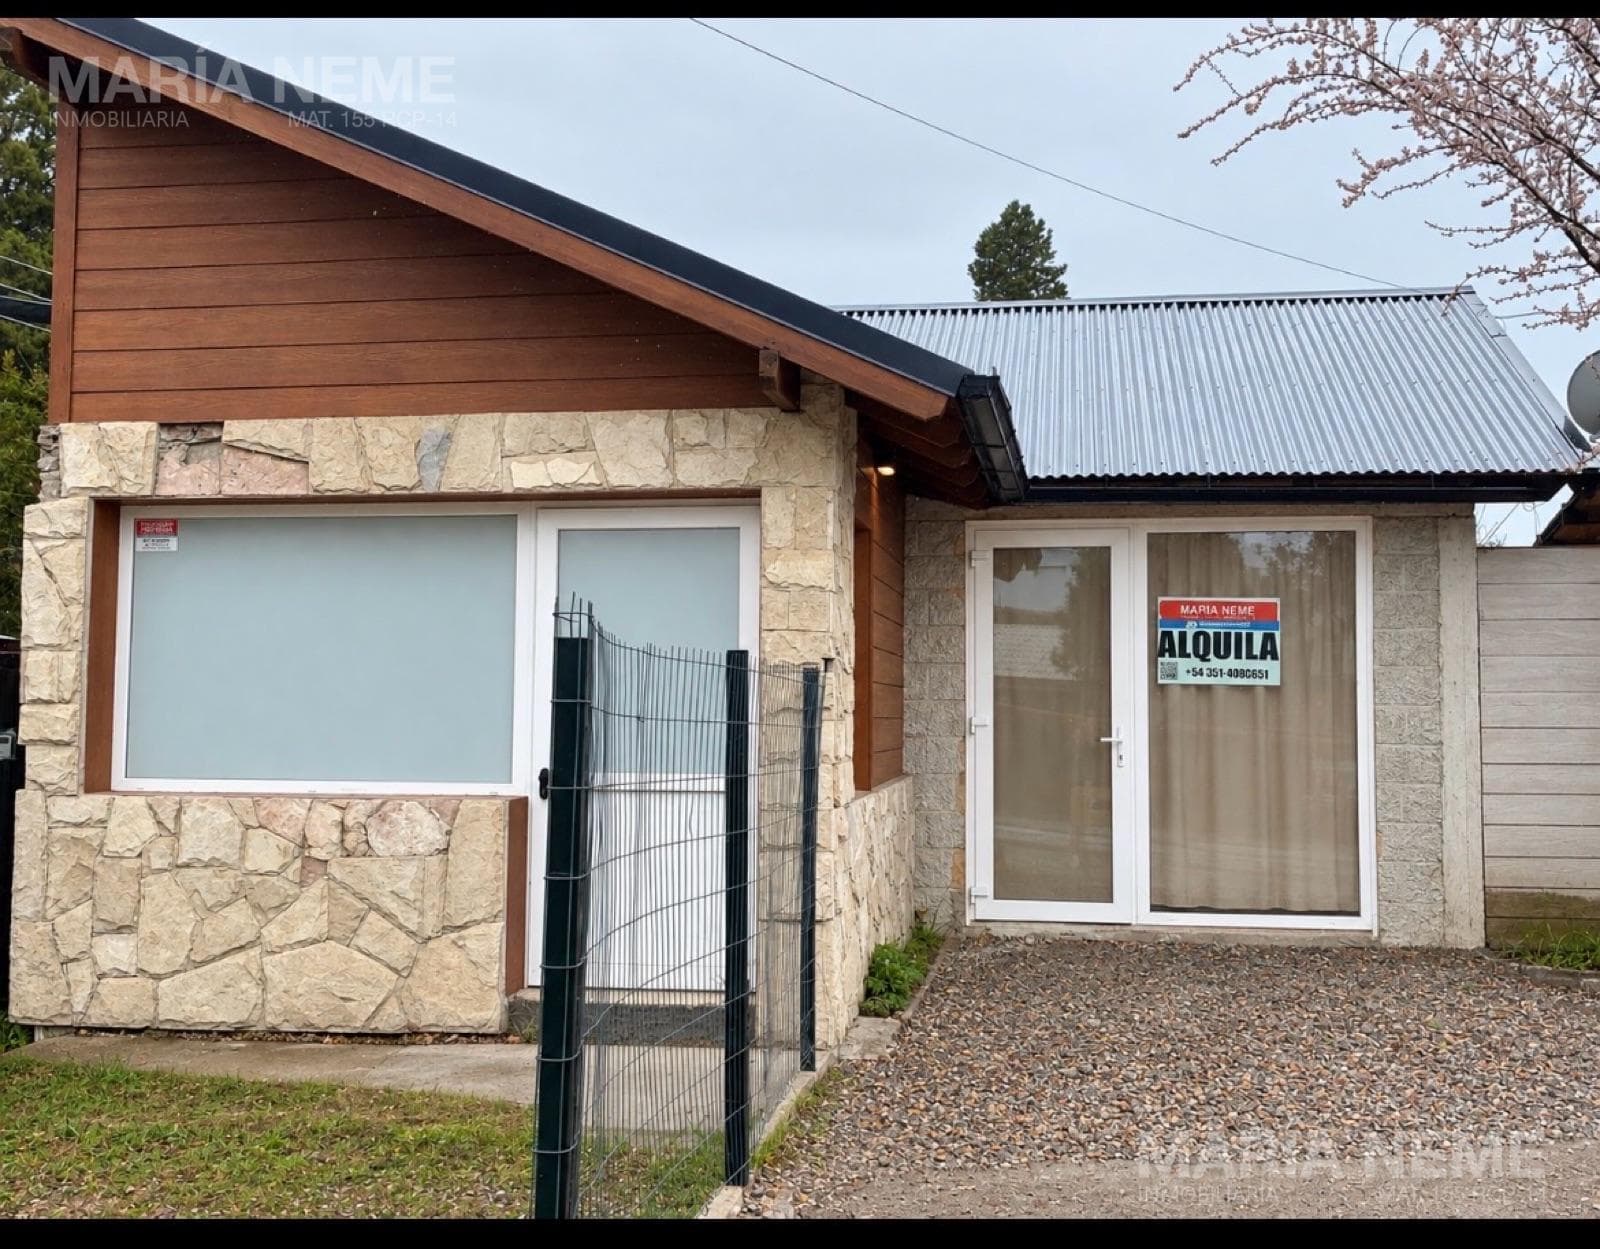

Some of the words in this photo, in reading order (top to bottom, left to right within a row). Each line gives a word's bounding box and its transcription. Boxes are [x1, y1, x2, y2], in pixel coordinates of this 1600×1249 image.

[1222, 605, 1255, 615] NEME
[1158, 630, 1279, 662] ALQUILA
[1186, 667, 1204, 677] +54
